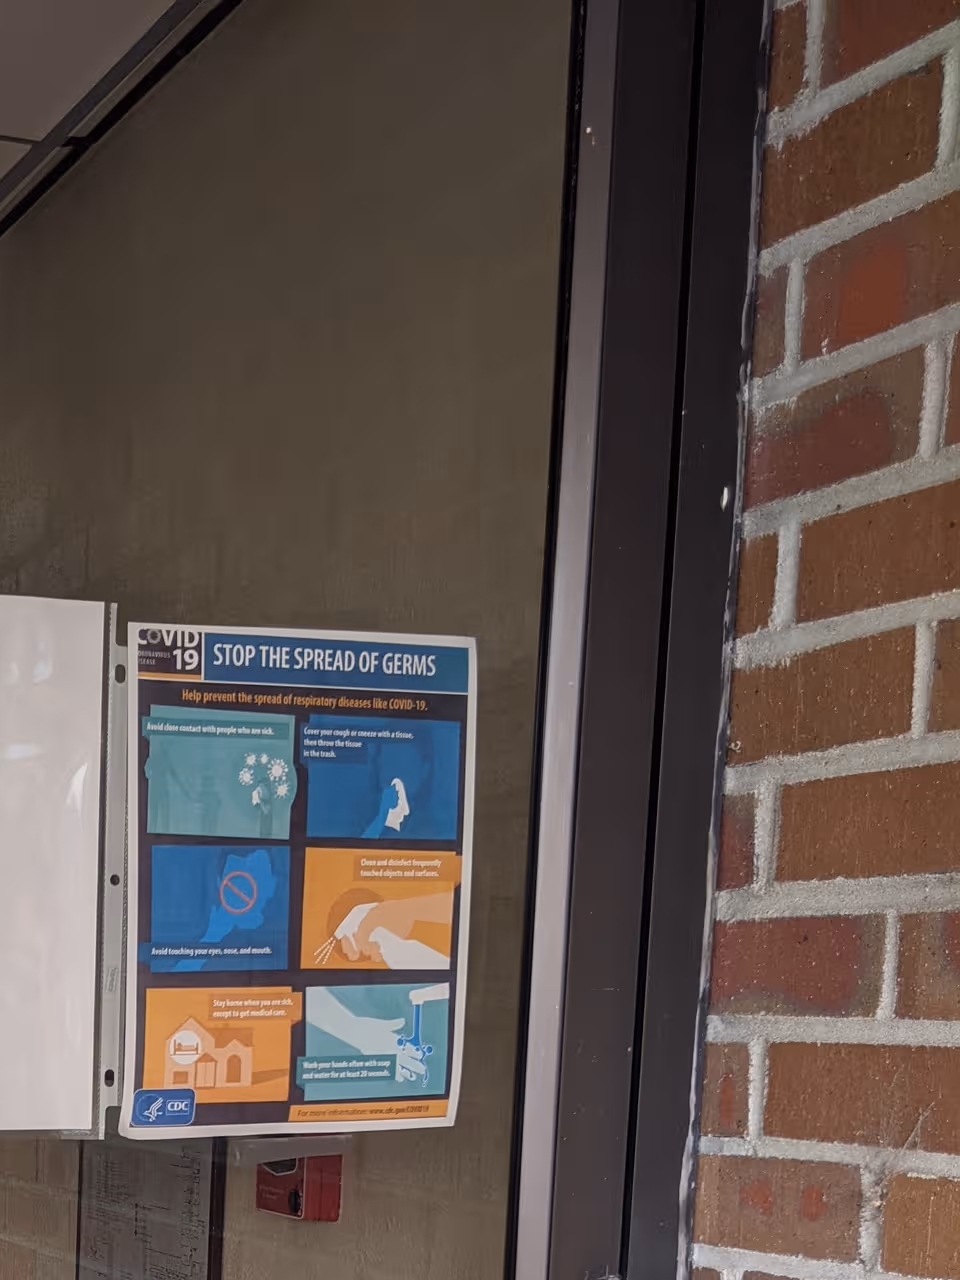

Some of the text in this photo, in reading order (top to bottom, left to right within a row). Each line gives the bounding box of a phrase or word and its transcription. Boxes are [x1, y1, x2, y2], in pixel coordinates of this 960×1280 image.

[138, 628, 200, 648] COVID
[172, 649, 200, 671] 19
[213, 643, 437, 676] STOP THE SPREAD OF GERMS
[182, 689, 428, 711] Help prevent the spread of respiratory diseases like COVID-19.
[146, 722, 164, 731] Avoid
[164, 723, 179, 732] close
[179, 724, 201, 733] contact
[202, 725, 216, 733] with
[216, 726, 237, 735] people
[261, 727, 275, 735] sick.
[167, 1101, 189, 1111] CDC
